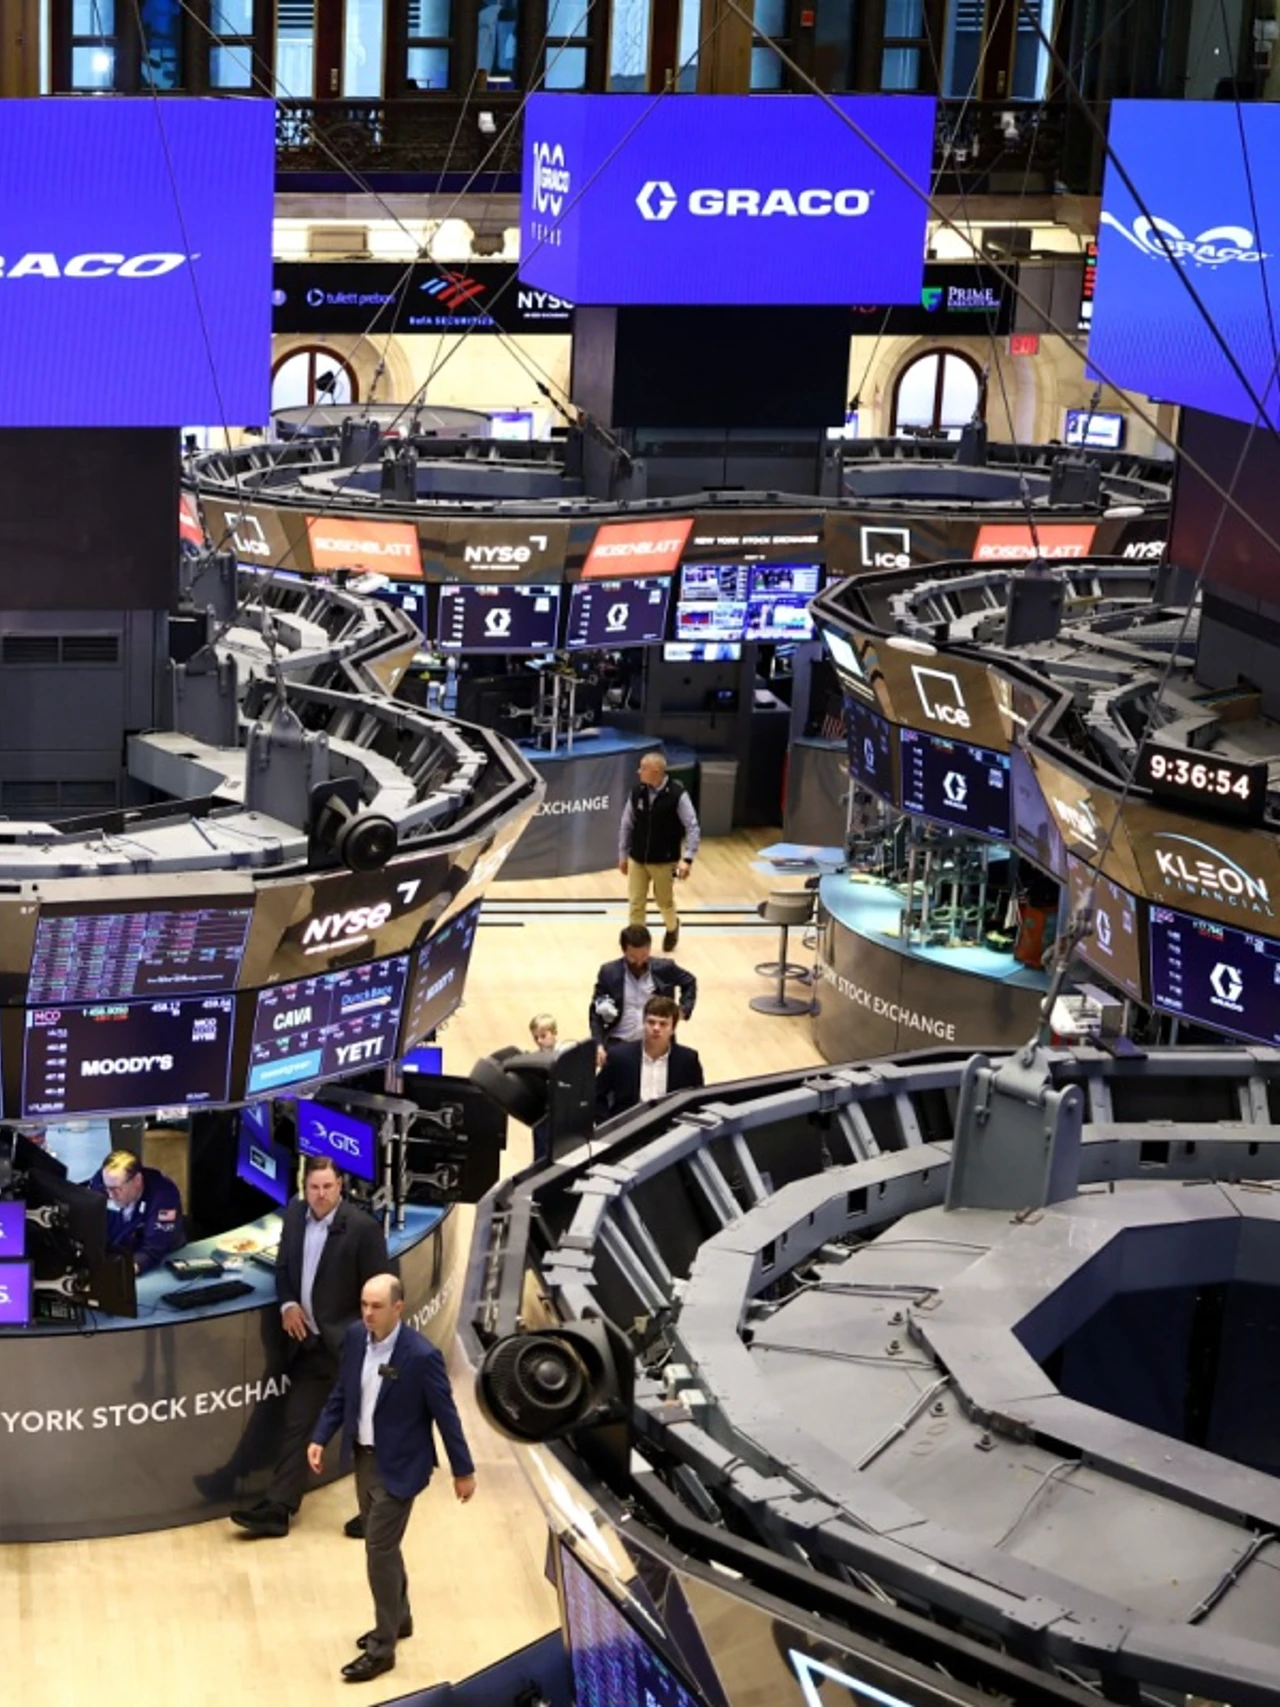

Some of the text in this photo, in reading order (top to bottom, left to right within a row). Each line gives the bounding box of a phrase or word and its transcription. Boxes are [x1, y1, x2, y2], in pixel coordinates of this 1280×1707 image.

[689, 190, 870, 216] GRACO
[1150, 754, 1250, 800] 9:36:54
[536, 795, 610, 817] XCHANGE
[1155, 848, 1271, 903] KLEON
[273, 1006, 313, 1031] CAVA
[872, 995, 957, 1042] EXCHANGE
[81, 1055, 174, 1077] MOODY'S
[335, 1036, 385, 1066] YETI
[1, 1408, 84, 1433] YORK
[92, 1396, 188, 1430] STOCK
[193, 1373, 292, 1416] EXCHAN
